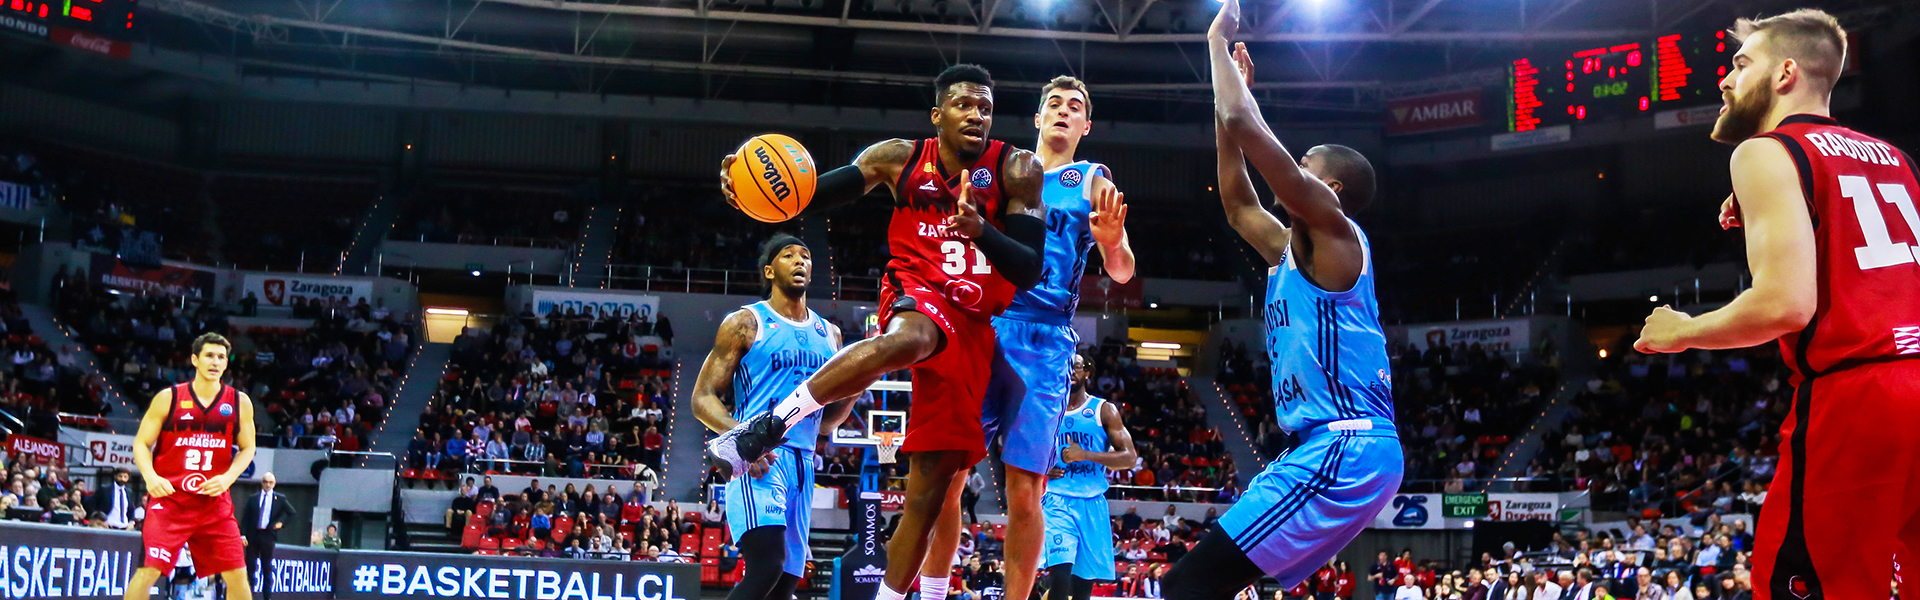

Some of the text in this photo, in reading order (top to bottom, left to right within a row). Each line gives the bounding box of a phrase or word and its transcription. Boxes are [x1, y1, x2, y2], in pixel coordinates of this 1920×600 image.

[0, 16, 48, 36] ONDO
[1411, 100, 1475, 122] AMBAR
[1804, 132, 1899, 167] RADOVIC
[754, 146, 791, 202] Wilson
[1837, 175, 1920, 270] 11
[940, 240, 992, 275] 31
[290, 280, 353, 297] Zaragoza
[1450, 326, 1510, 341] Zaragoza
[771, 349, 829, 372] BRINDI
[13, 438, 60, 458] ALEJANDRO
[175, 436, 226, 448] ZARAGOZA
[1059, 431, 1093, 448] INDISI
[185, 449, 214, 471] 21
[1445, 495, 1484, 505] EMERGENCY
[1453, 506, 1477, 516] EXIT
[1505, 500, 1552, 511] Zaragoza
[864, 503, 877, 556] SOMMOS
[0, 545, 160, 599] ASKETBALL
[253, 557, 332, 592] BSKETBALLCL
[353, 563, 687, 600] #BASKETBALLCL
[854, 576, 883, 584] SOMMO
